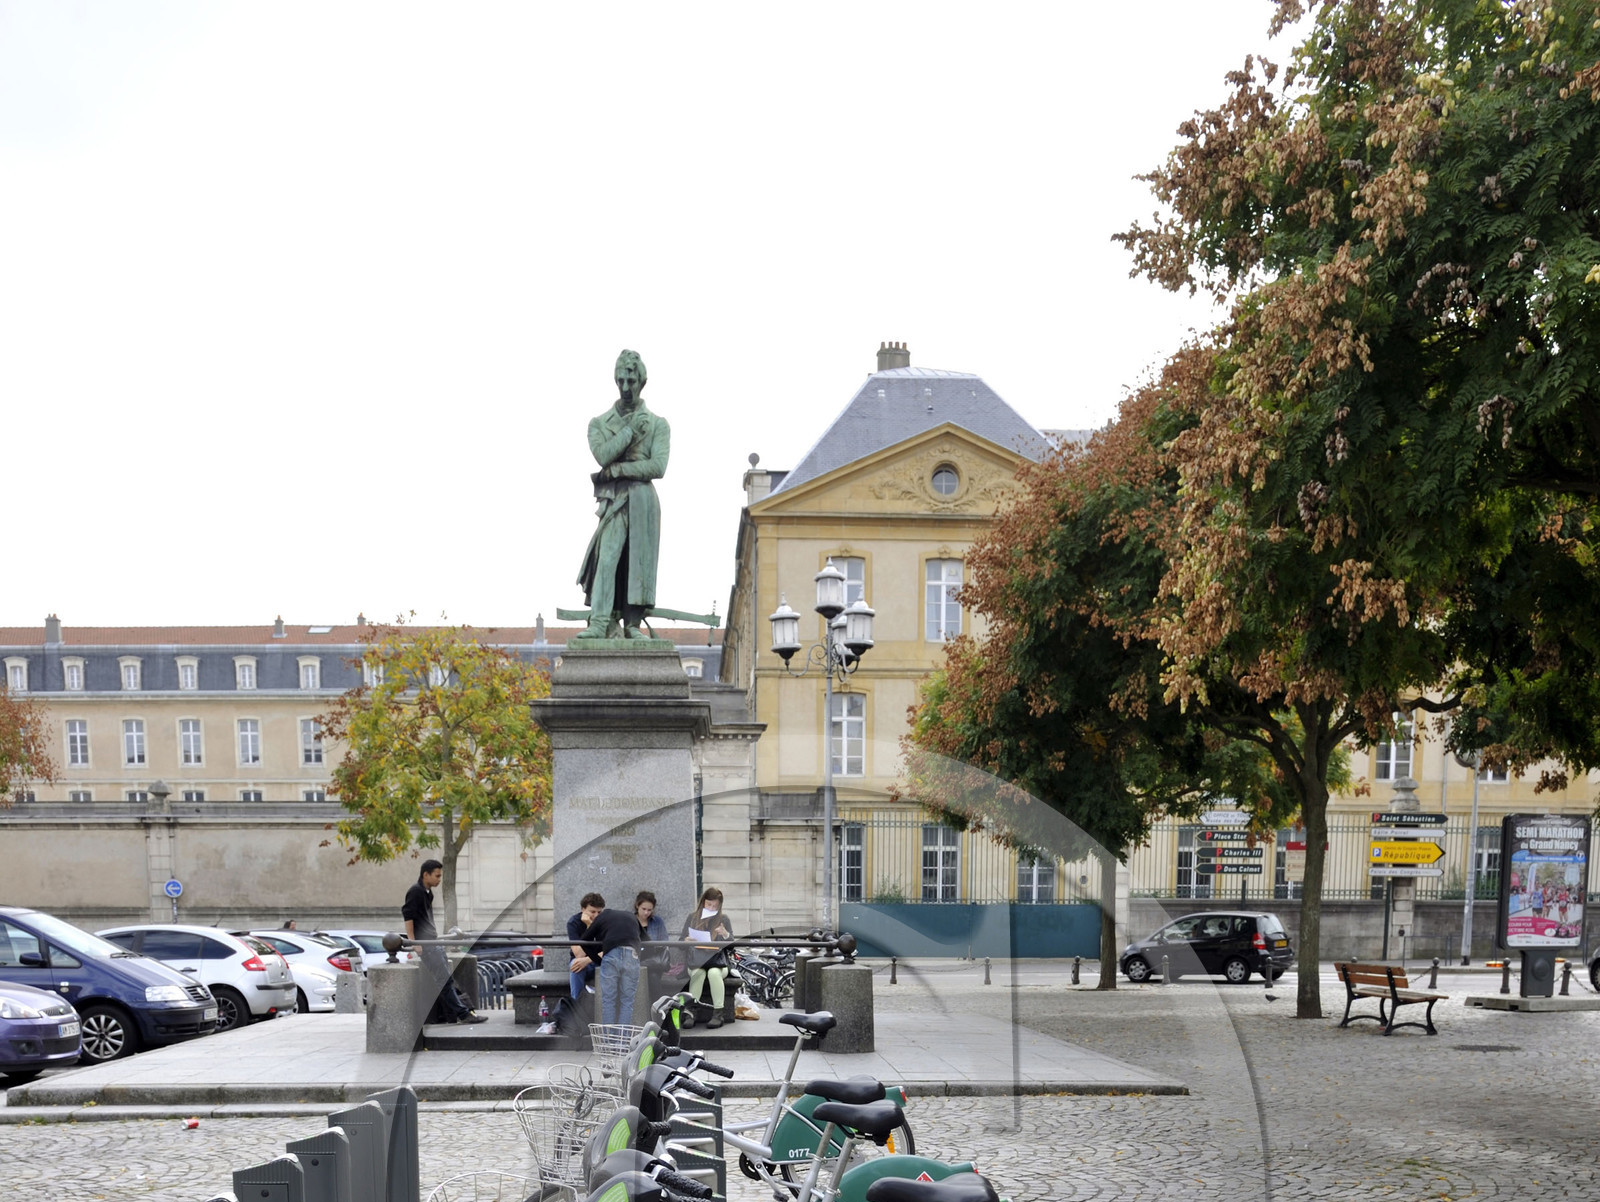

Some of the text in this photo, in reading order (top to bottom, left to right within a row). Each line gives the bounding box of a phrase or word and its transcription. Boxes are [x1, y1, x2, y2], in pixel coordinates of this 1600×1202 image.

[1515, 827, 1585, 839] SEMI MARATHON
[1529, 840, 1553, 849] Grand
[1554, 841, 1579, 850] Nancy
[1384, 852, 1431, 860] République
[788, 1148, 811, 1158] 0177
